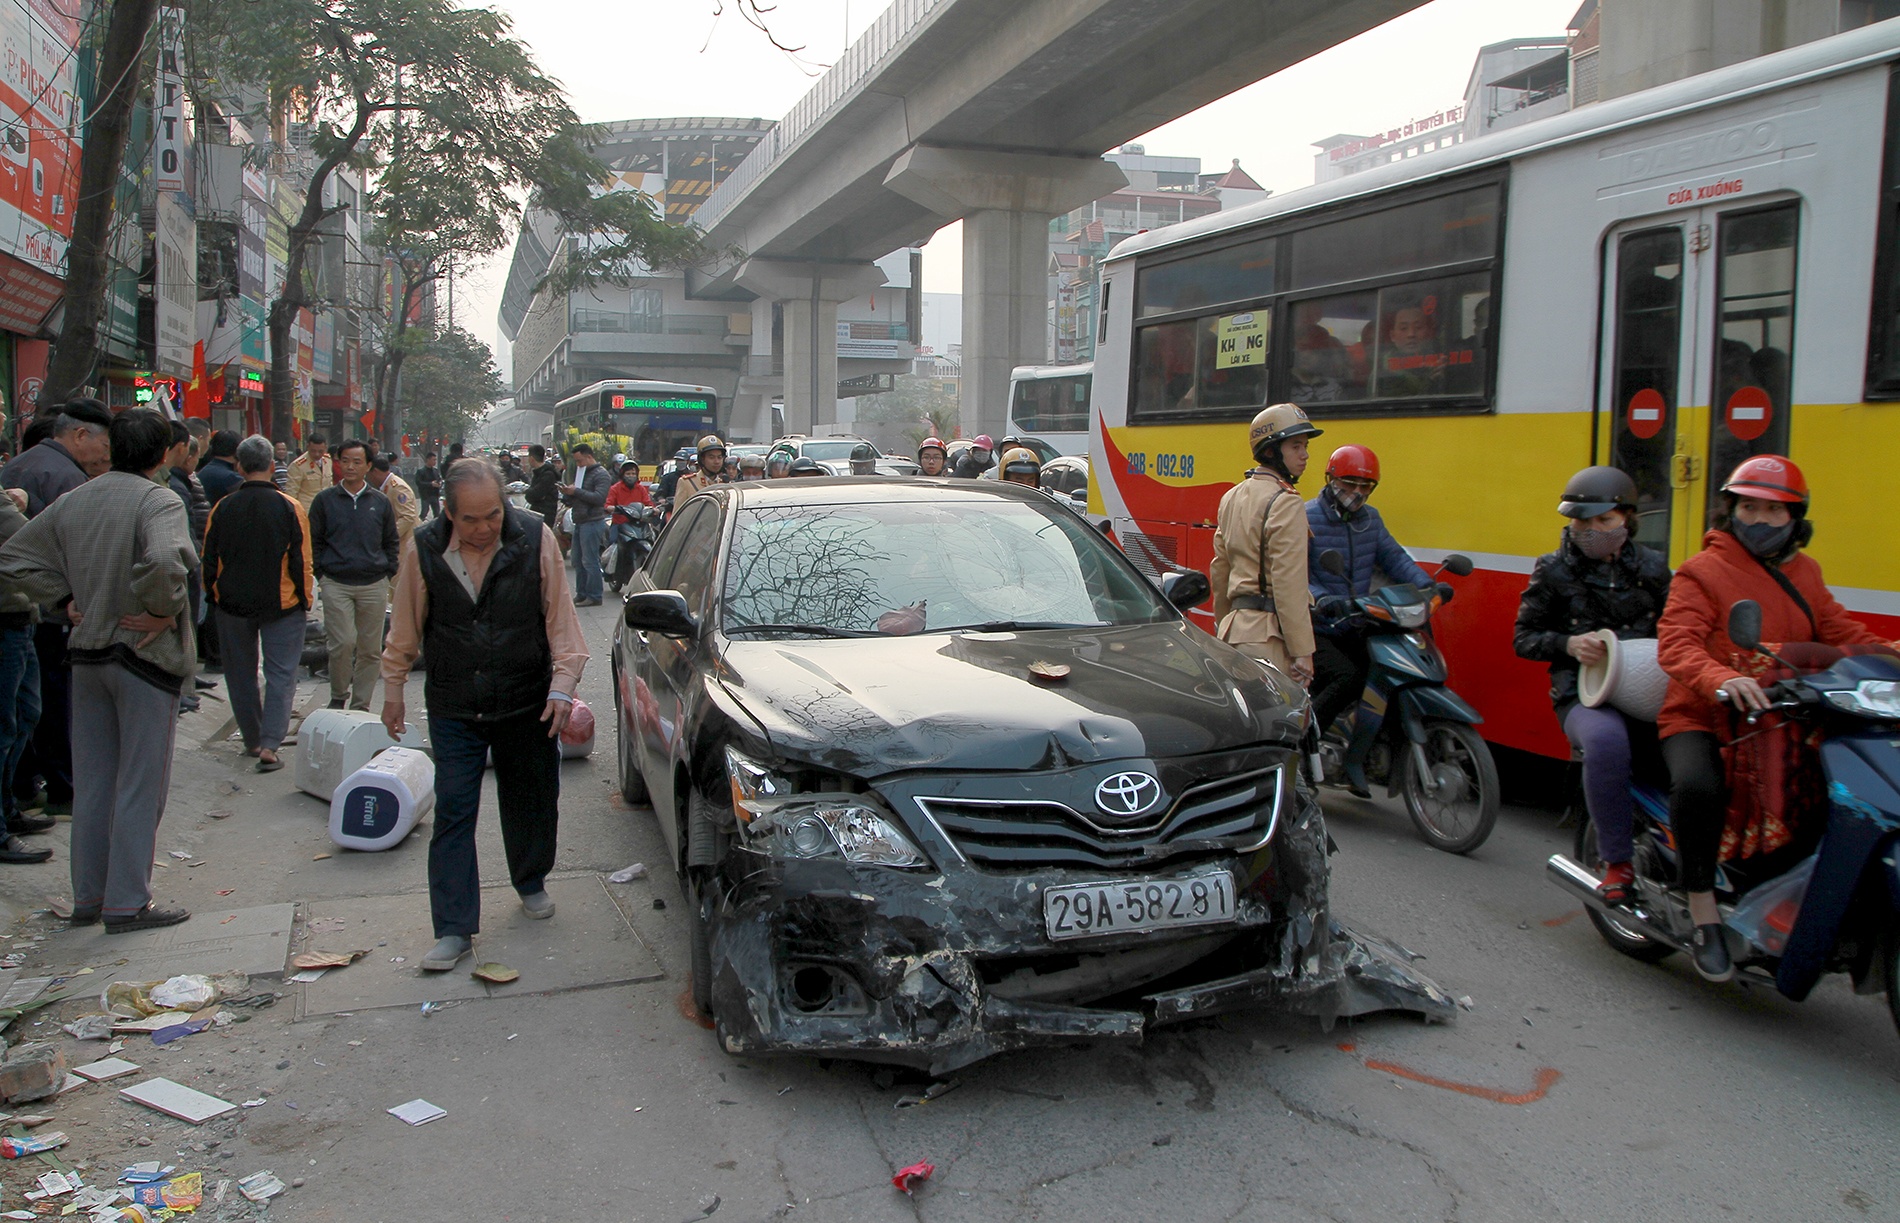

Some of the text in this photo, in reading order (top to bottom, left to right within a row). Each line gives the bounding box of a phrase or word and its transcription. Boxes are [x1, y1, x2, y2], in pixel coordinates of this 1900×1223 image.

[20, 57, 64, 121] PICENZA
[1696, 177, 1744, 200] XUỐNG
[1251, 423, 1275, 439] CSGT
[1127, 452, 1146, 475] 29B
[1156, 453, 1195, 479] 092.98
[1052, 878, 1226, 933] 29A-582.81
